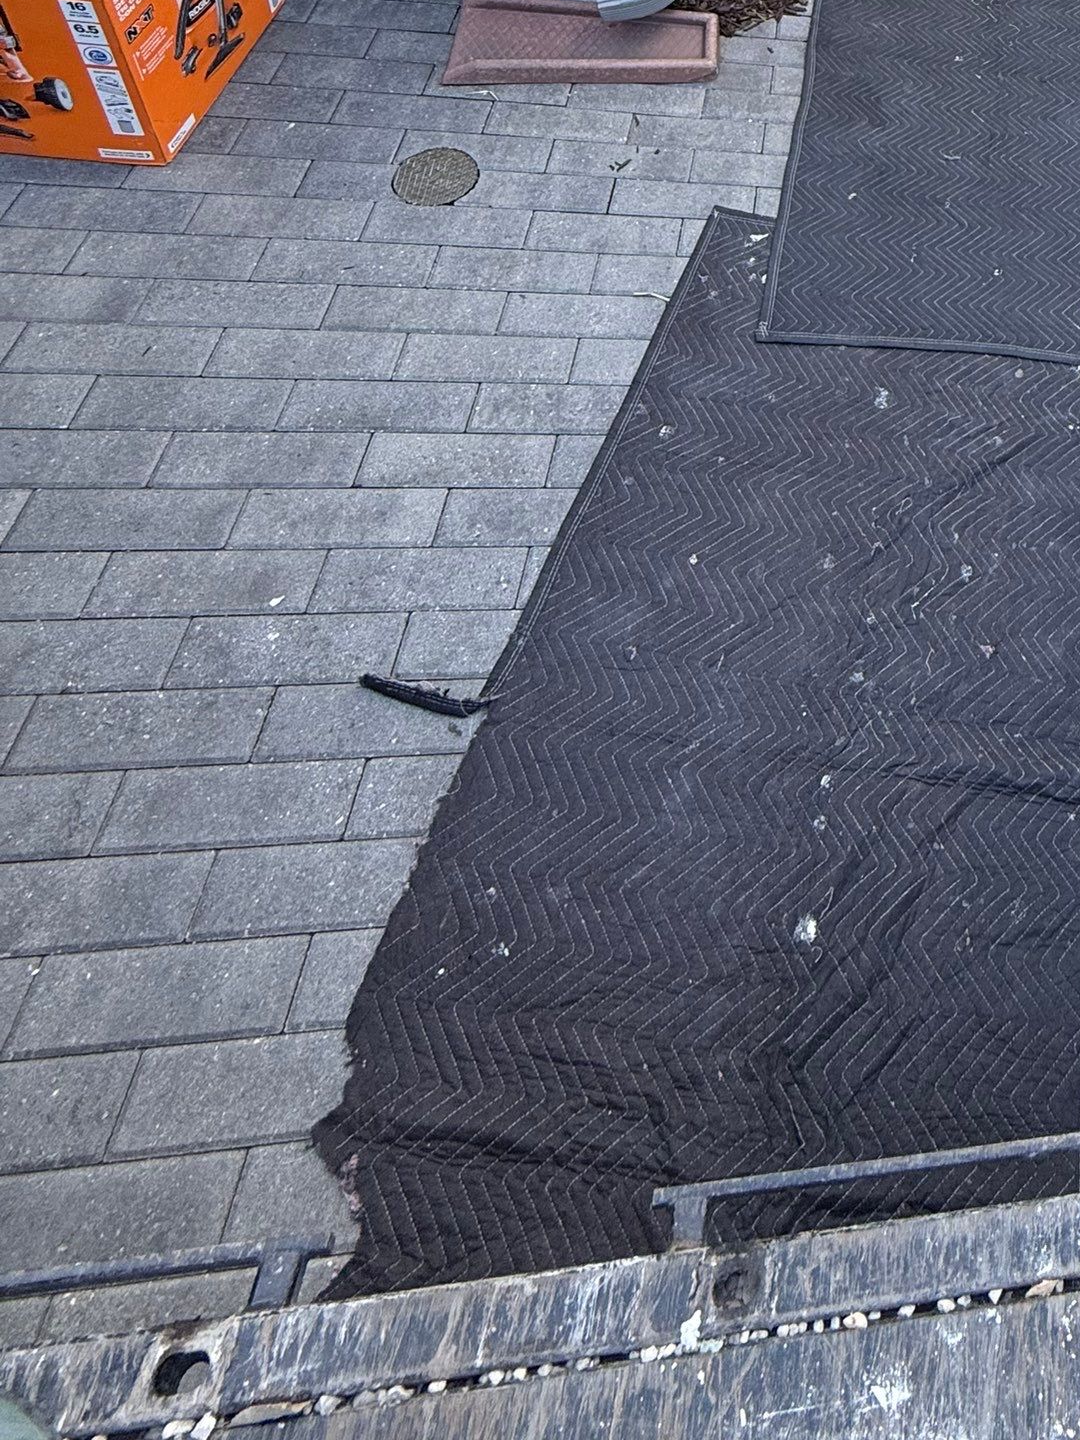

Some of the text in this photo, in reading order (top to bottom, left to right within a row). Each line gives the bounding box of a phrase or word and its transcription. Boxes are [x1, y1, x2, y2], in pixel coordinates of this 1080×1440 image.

[66, 1, 86, 11] 16
[73, 23, 99, 34] 6.5
[126, 5, 154, 43] NXT
